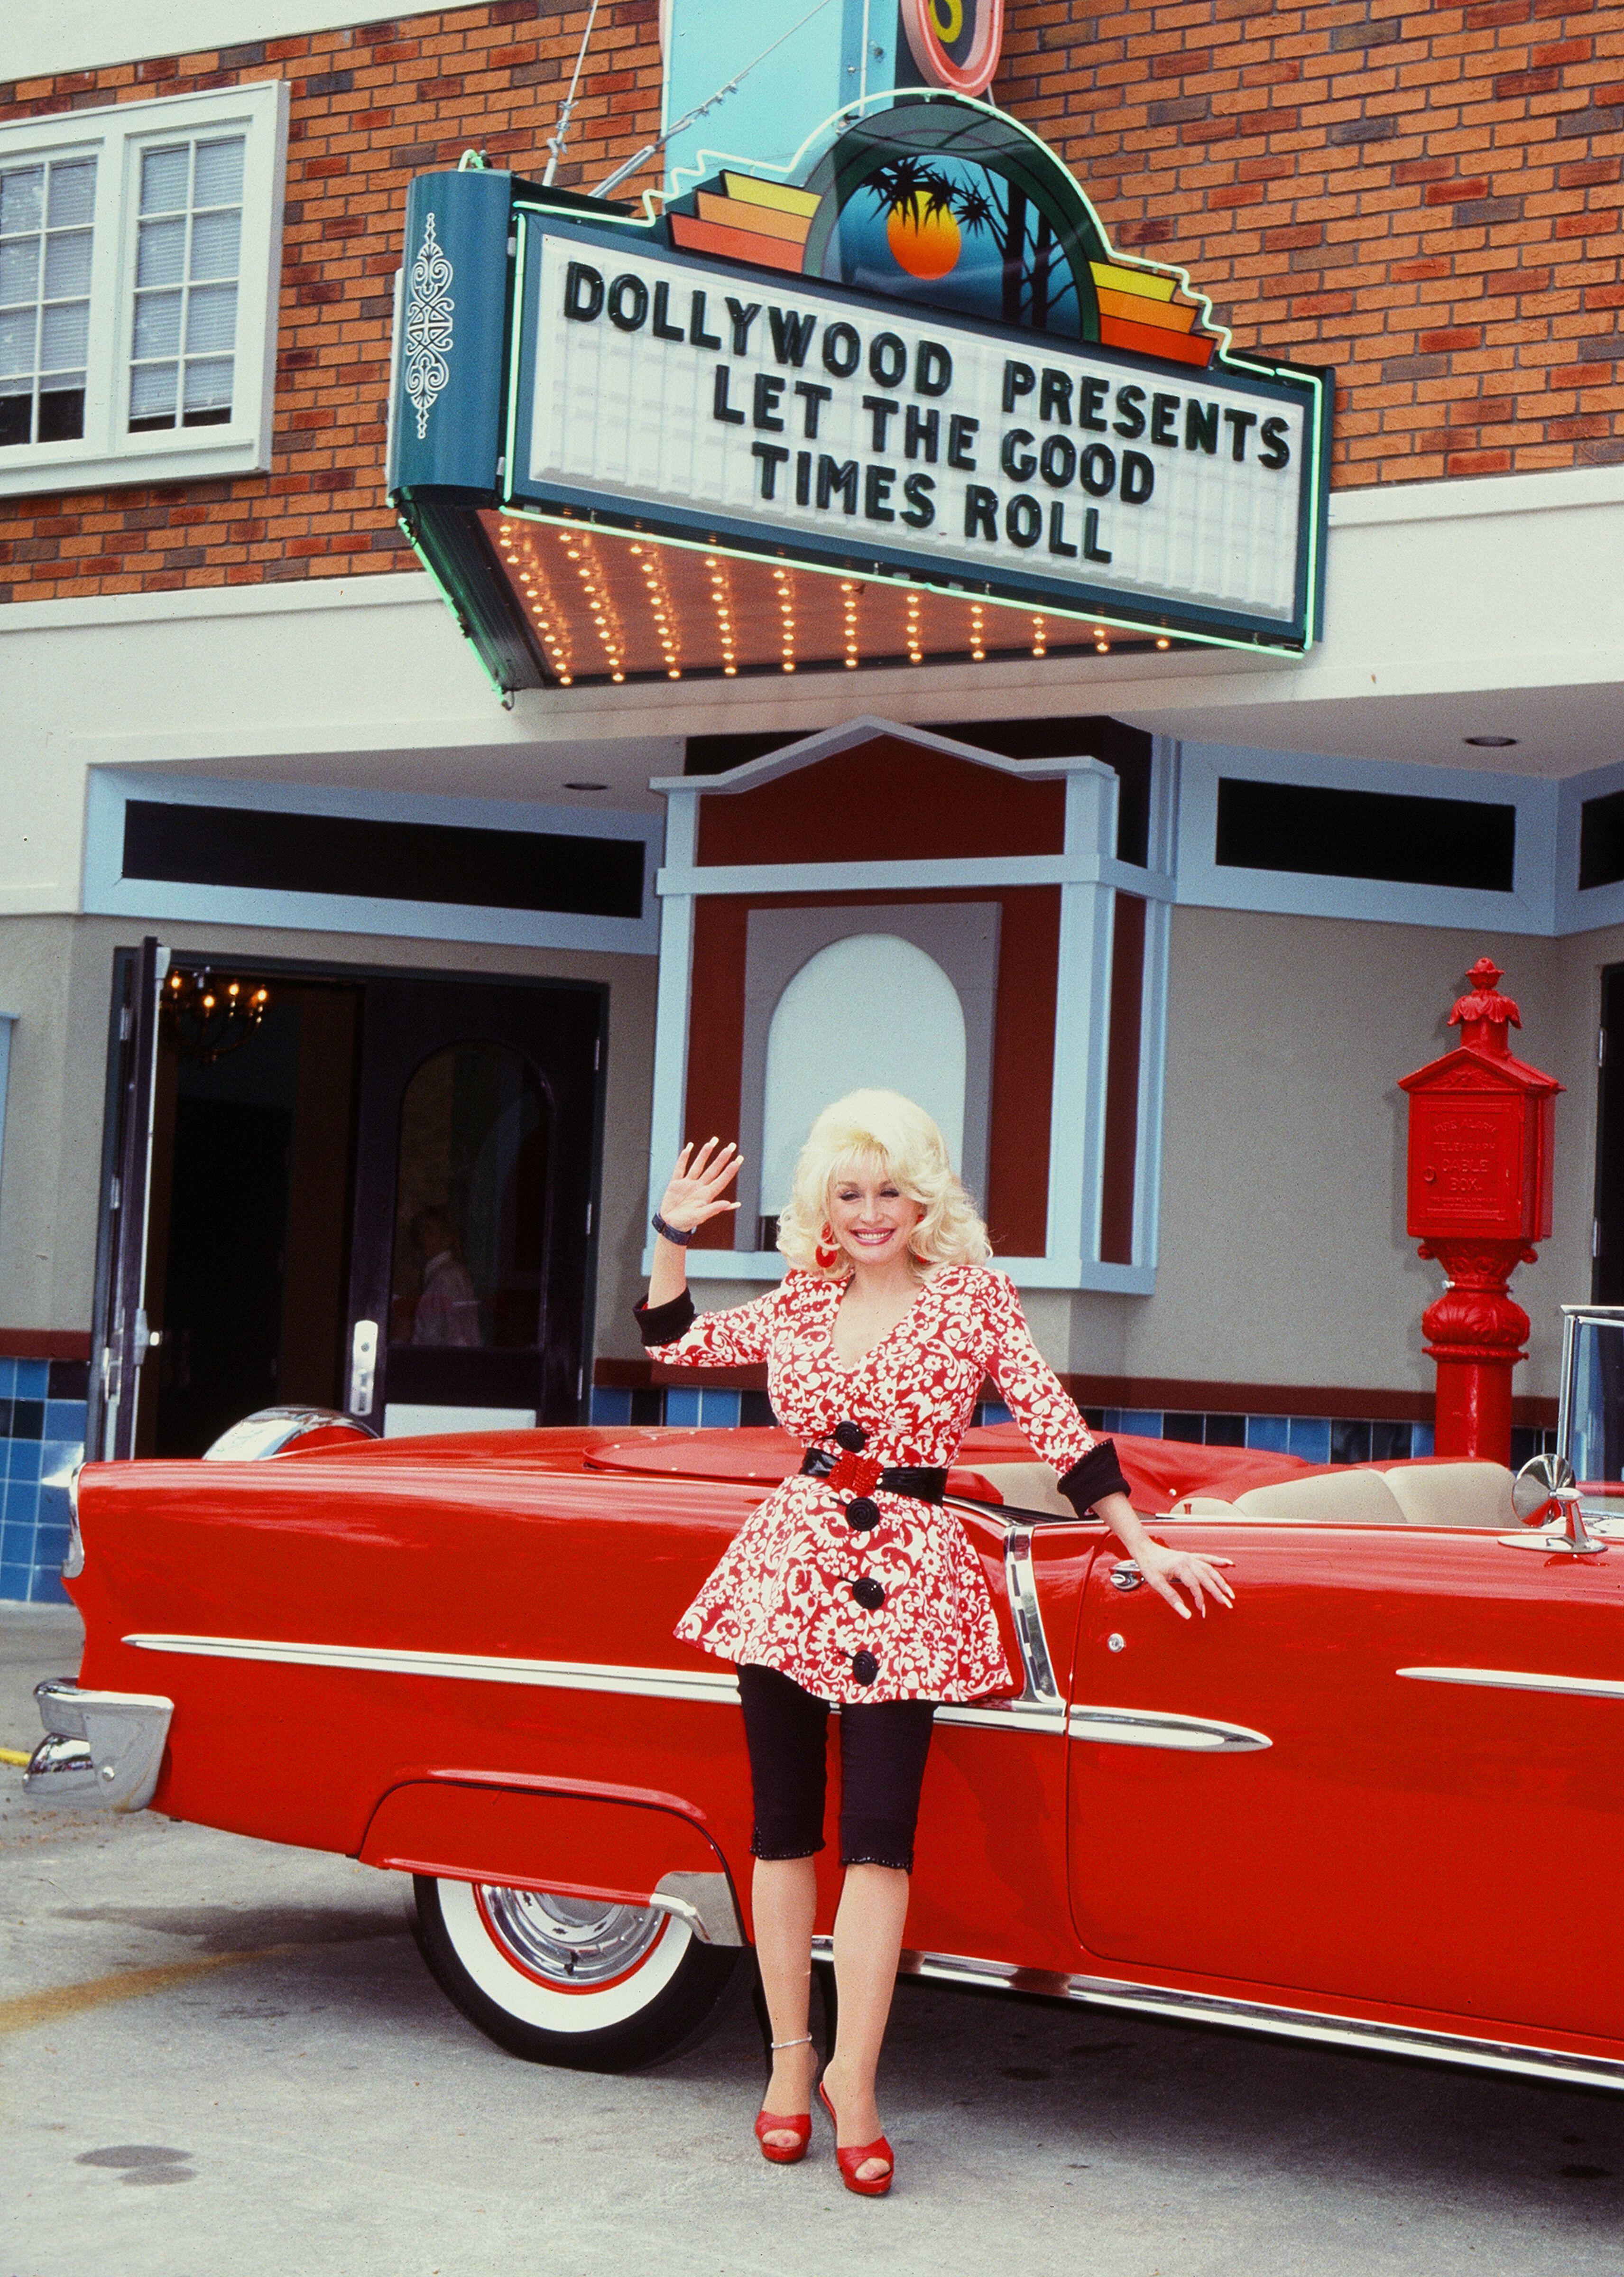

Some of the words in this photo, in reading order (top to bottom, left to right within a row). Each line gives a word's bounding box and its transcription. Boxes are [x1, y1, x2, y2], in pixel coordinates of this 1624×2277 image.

[564, 262, 952, 397] DOLLYWOOD
[1002, 361, 1290, 470] PRESENTS
[714, 365, 831, 439] LET
[863, 396, 978, 471] THE
[1001, 429, 1154, 504] GOOD
[752, 442, 935, 528] TIMES
[965, 485, 1111, 564] ROLL
[1442, 1159, 1490, 1172] CABLE
